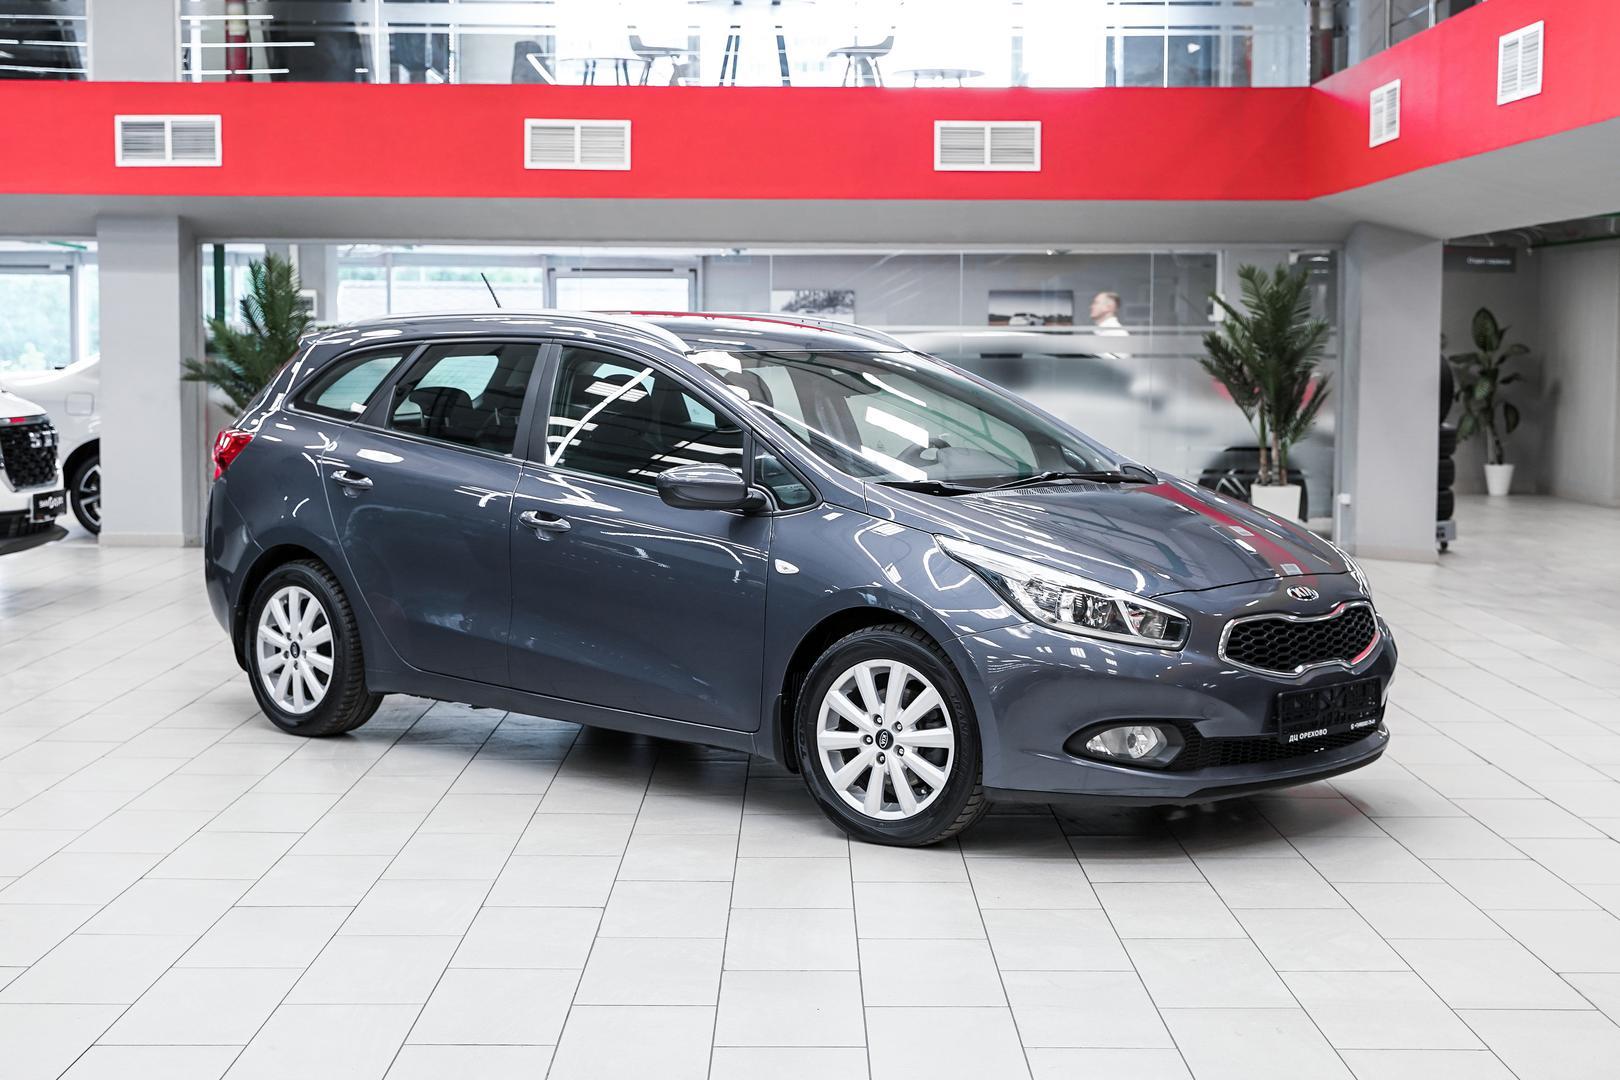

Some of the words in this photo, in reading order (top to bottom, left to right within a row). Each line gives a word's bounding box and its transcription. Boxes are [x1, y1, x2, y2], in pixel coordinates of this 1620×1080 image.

[1289, 586, 1317, 599] KIA
[1289, 734, 1299, 743] ДЦ
[1299, 729, 1328, 740] ОРЕХОВО
